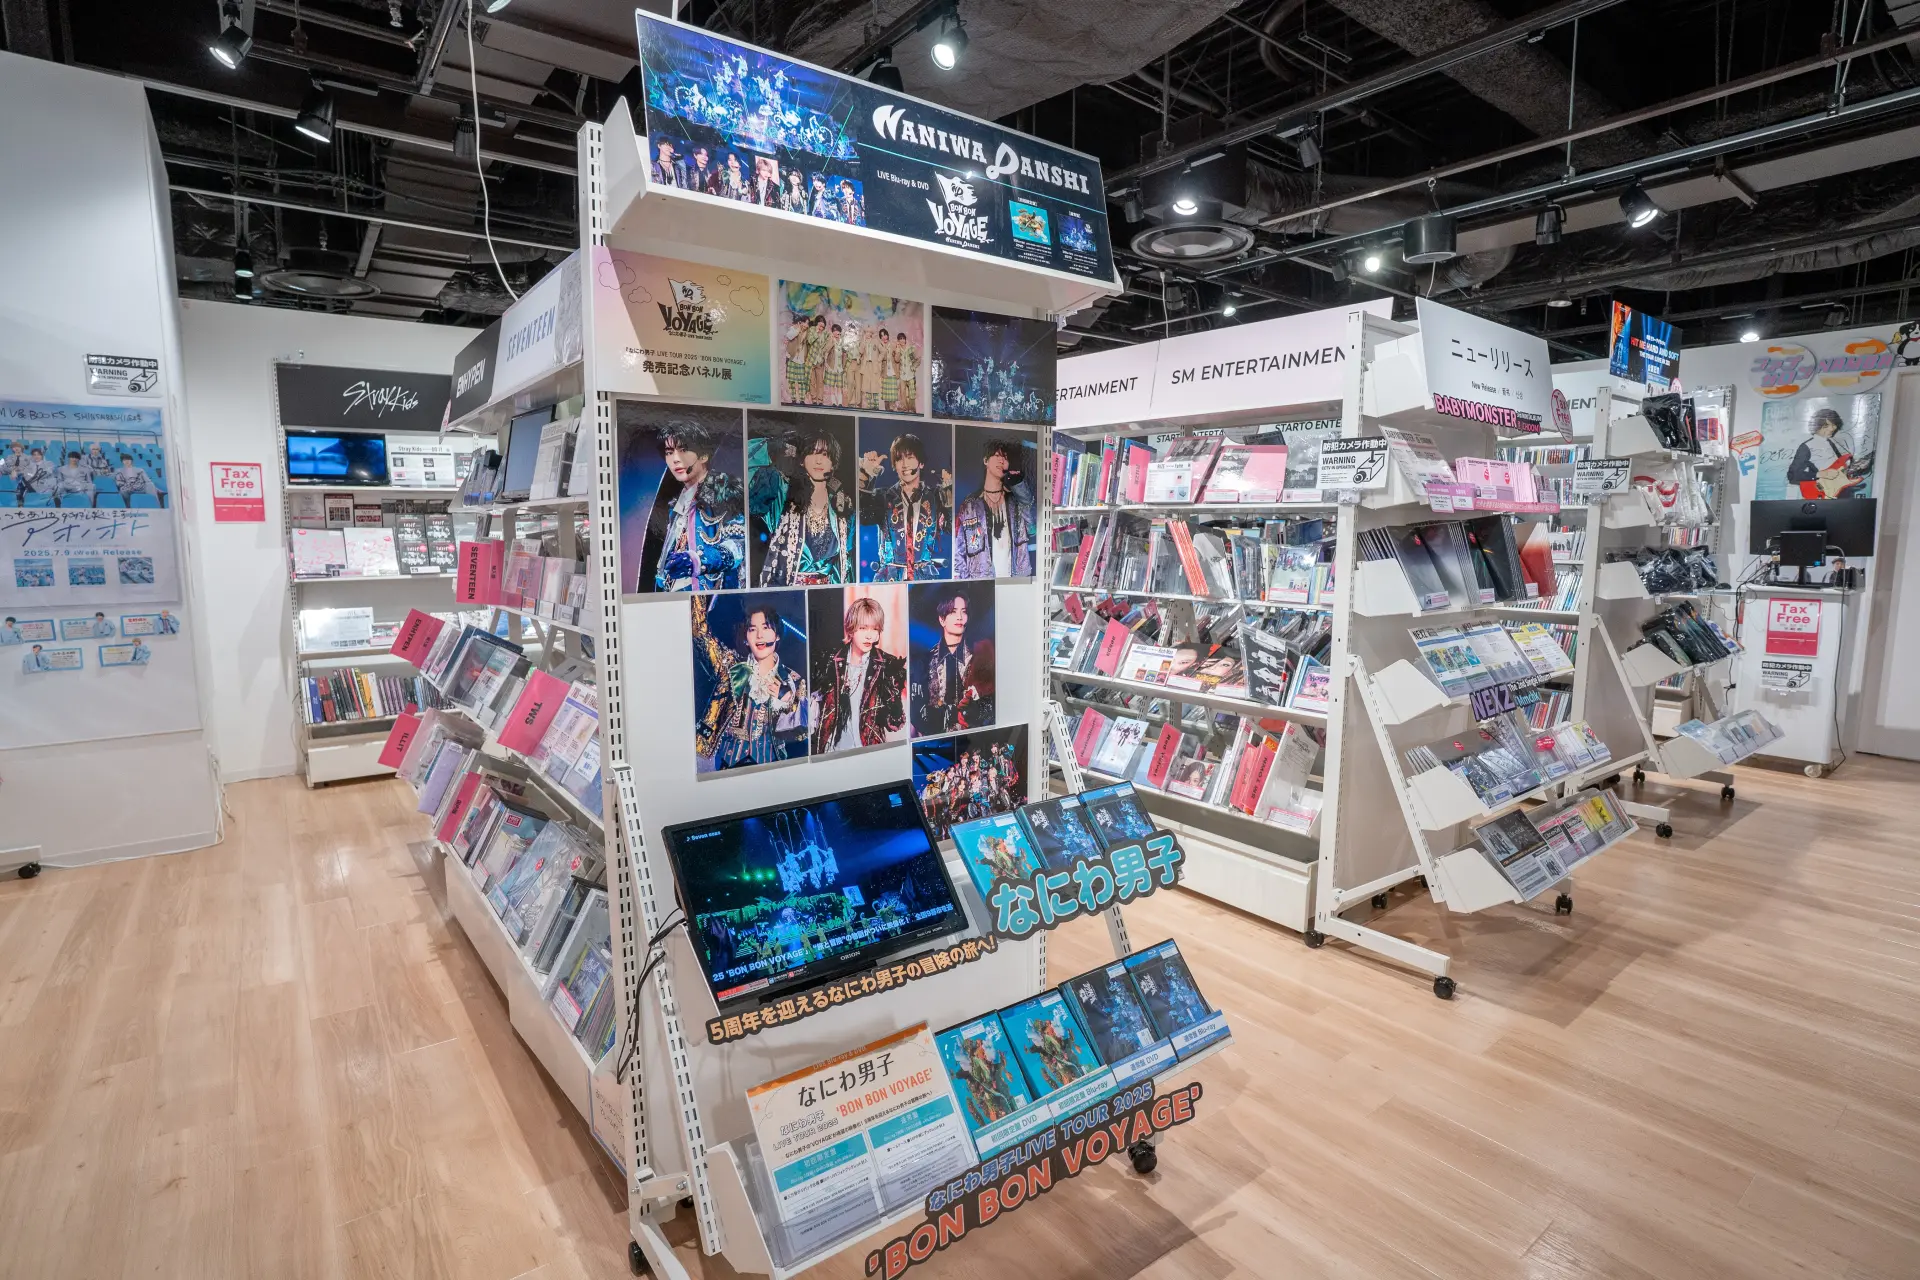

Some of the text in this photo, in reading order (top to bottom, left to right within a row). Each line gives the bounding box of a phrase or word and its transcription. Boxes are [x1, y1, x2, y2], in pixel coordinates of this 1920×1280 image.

[872, 104, 1090, 195] NANIWA DANSHI
[877, 169, 930, 191] LIVE Blu-ray & DVD
[926, 198, 990, 243] VOYAGE
[950, 203, 976, 216] BON BON
[657, 301, 718, 335] VOYAGE
[680, 303, 704, 313] BON BON
[506, 305, 556, 363] SEVENTEEN
[1171, 345, 1348, 385] SM ENTERTAINMEN
[1451, 338, 1534, 379] ニューリリース
[1668, 350, 1680, 361] SOFT
[456, 358, 486, 399] ENHYPEN
[642, 360, 733, 381] 発売記念パネル展
[1472, 380, 1481, 390] New
[1481, 382, 1497, 394] Release
[1433, 392, 1518, 429] BABYMONSTER
[1554, 393, 1568, 410] Tax
[1556, 408, 1571, 424] Free
[1322, 438, 1387, 452] 防犯カメラ作動中
[1322, 456, 1356, 465] WARNING
[221, 467, 250, 479] Tax
[221, 478, 254, 489] Free
[467, 545, 479, 600] SEVENTEEN
[1776, 613, 1811, 625] Free
[1779, 603, 1808, 614] Tax
[401, 618, 422, 653] ENHYPEN
[1507, 682, 1518, 692] The
[524, 701, 543, 726] TWS
[1470, 684, 1516, 721] NEXZ
[395, 732, 410, 754] ILLIT
[1153, 733, 1172, 778] Red Velvet
[1251, 756, 1268, 800] SM TOWN
[991, 834, 1182, 935] なにわ男子
[840, 950, 861, 961] ORION
[749, 960, 768, 974] BON
[709, 934, 995, 1042] 5周年を迎えるなにわ男子の冒険の旅へ!
[1197, 1021, 1217, 1037] Blu-ray
[1145, 1052, 1159, 1064] DVD
[798, 1052, 895, 1108] なにわ男子
[1086, 1080, 1108, 1096] Blu-ray
[865, 1090, 889, 1107] BON
[779, 1109, 826, 1136] なにわ男子
[1022, 1113, 1038, 1128] DVD
[1060, 1104, 1110, 1141] TOUR
[1113, 1082, 1153, 1121] 2025
[772, 1117, 839, 1151] LIVE TOUR 2025
[978, 1157, 1051, 1224] BON
